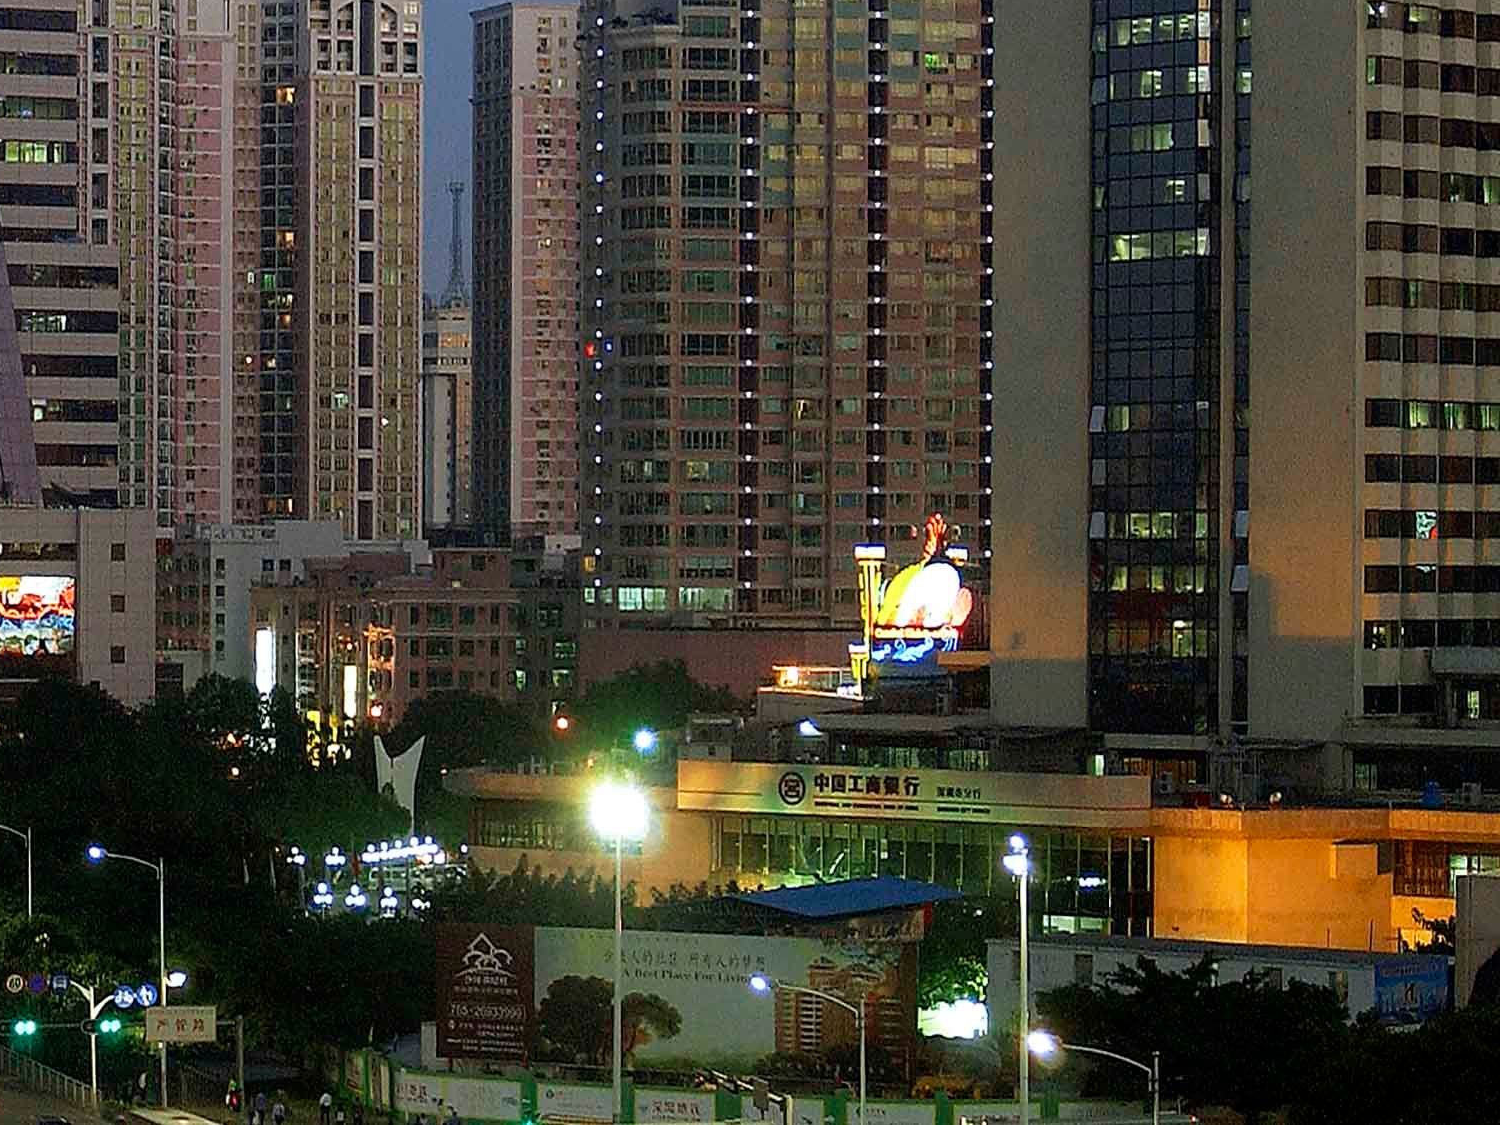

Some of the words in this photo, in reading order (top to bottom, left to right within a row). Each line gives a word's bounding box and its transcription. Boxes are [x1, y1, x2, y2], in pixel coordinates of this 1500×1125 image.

[814, 772, 920, 797] 中国工商银行
[717, 972, 750, 984] Livin
